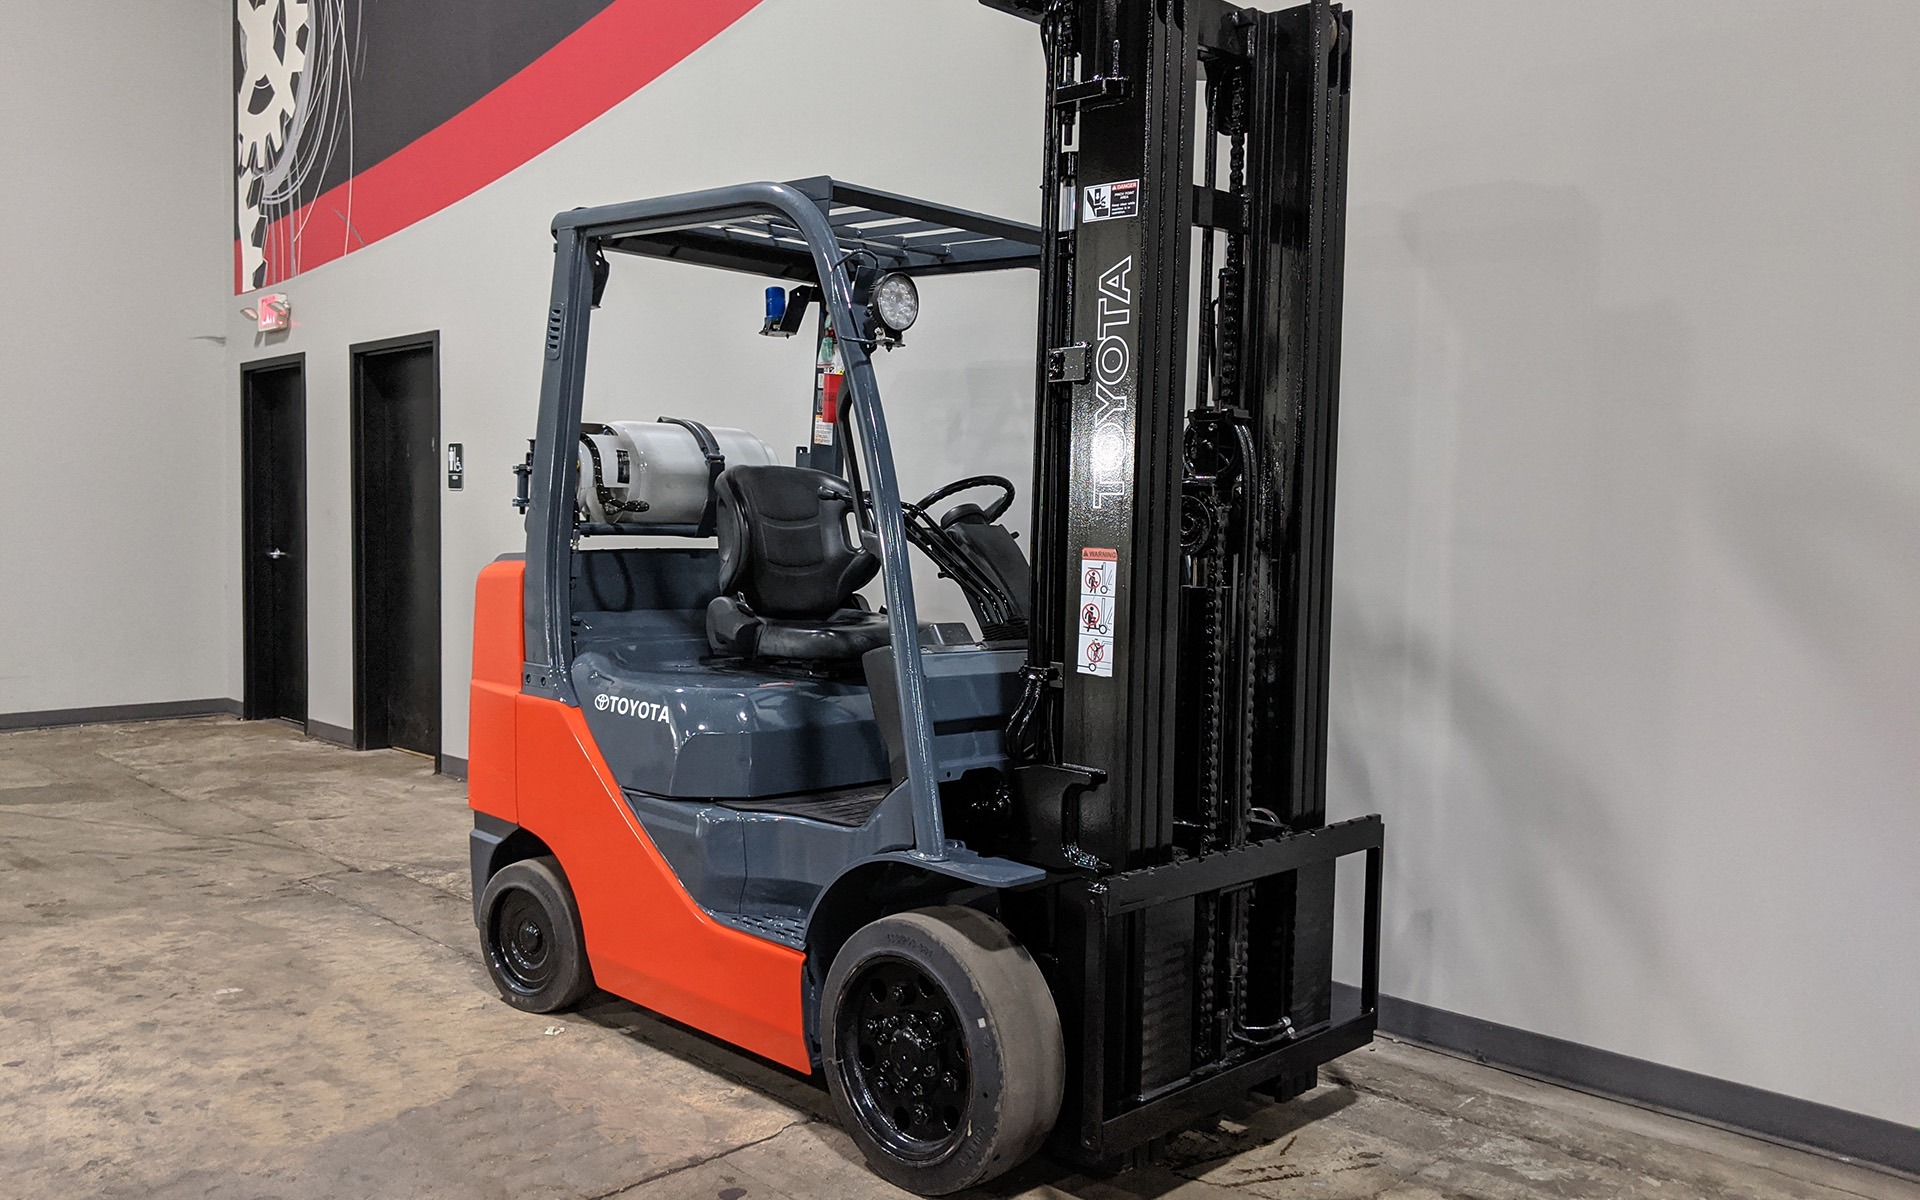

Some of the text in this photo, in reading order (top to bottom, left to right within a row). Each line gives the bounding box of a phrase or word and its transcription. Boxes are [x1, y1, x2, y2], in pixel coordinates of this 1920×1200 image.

[1092, 255, 1132, 508] TOYOTA
[1089, 550, 1117, 558] WARNING
[610, 695, 670, 724] TOYOTA
